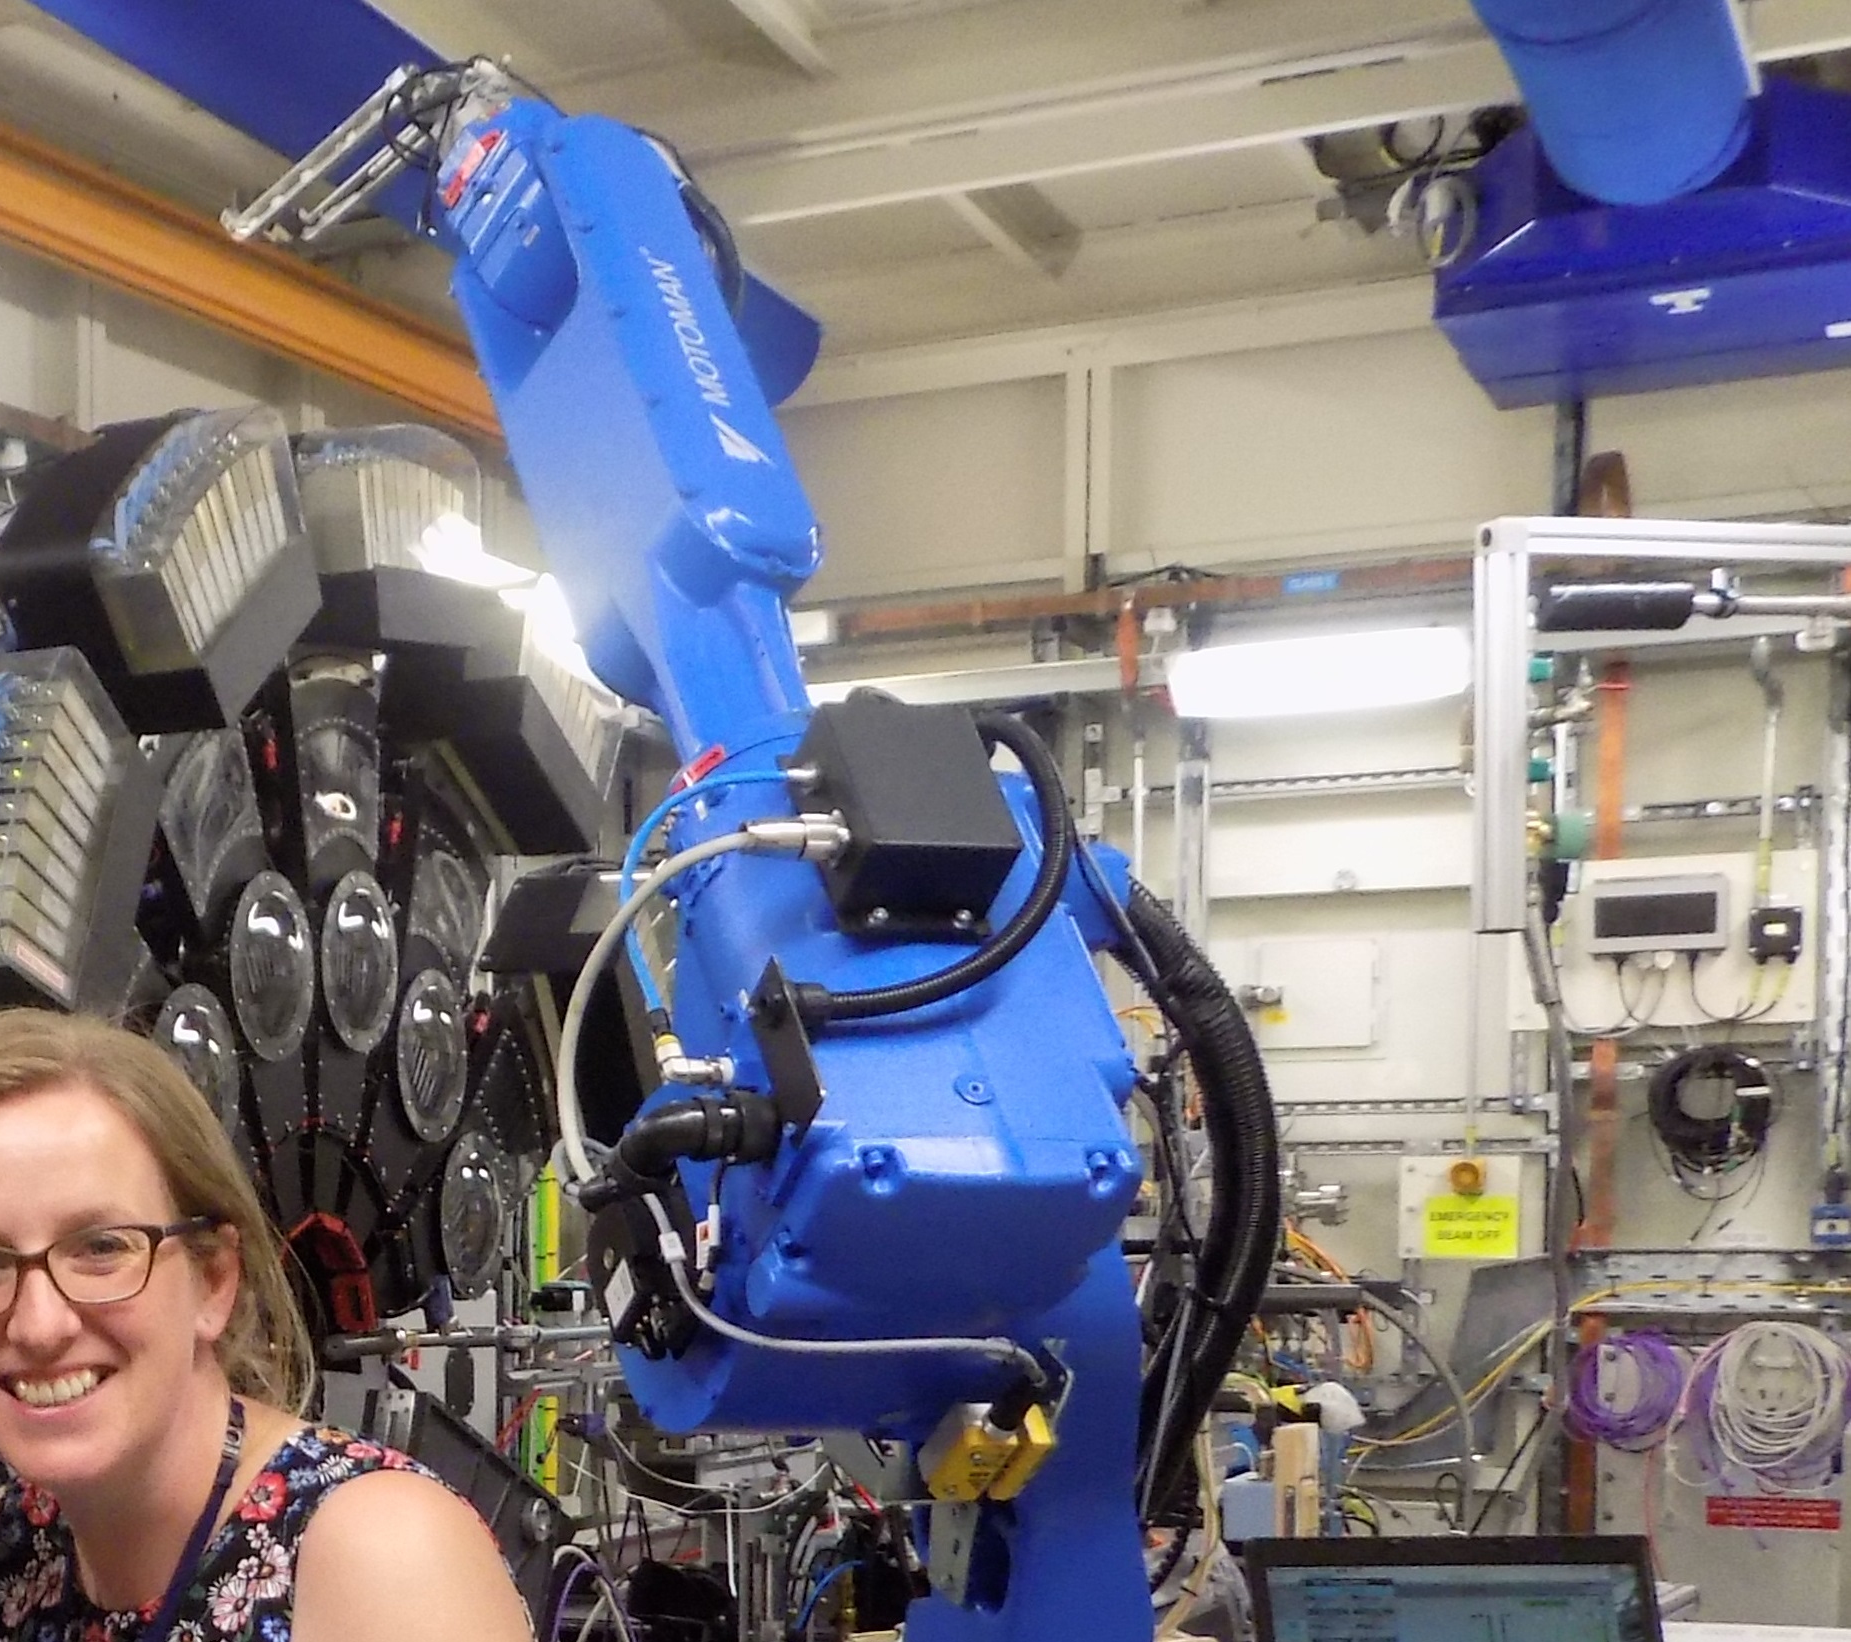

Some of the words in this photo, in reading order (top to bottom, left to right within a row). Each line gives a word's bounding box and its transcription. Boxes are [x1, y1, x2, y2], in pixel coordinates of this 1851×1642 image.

[648, 257, 732, 407] MOTOMAN
[1429, 1211, 1509, 1222] EMERGENCY
[1437, 1230, 1473, 1240] BEAM
[1476, 1230, 1501, 1240] OFF
